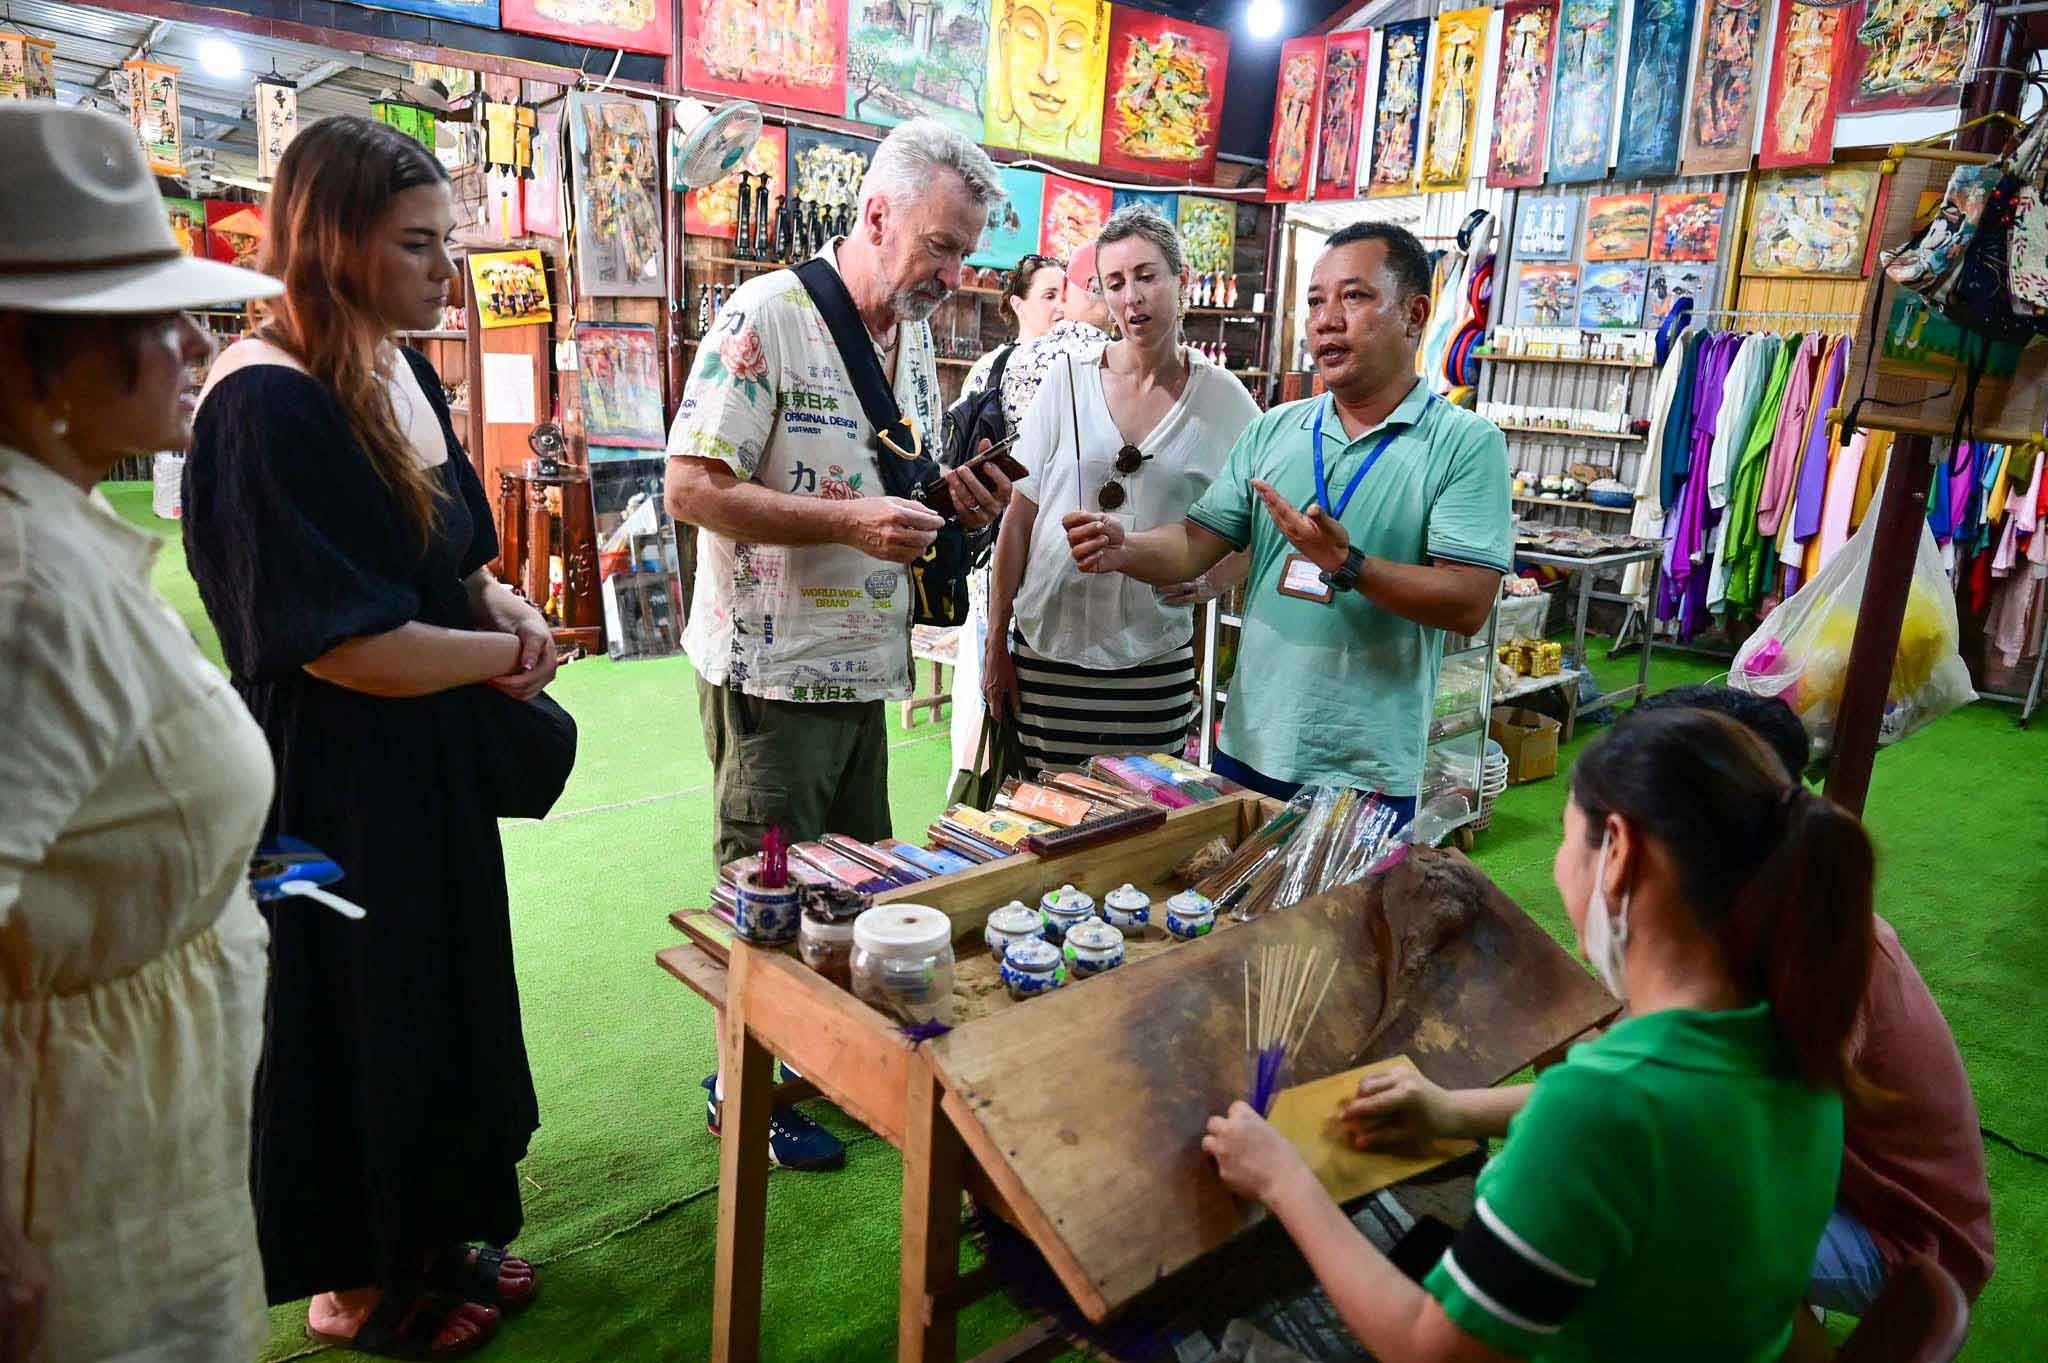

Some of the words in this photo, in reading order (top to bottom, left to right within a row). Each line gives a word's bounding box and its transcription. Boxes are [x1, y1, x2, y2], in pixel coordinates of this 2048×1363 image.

[784, 412, 828, 425] ORIGINAL
[829, 415, 857, 429] DESIGN
[789, 460, 816, 493] 力
[800, 588, 837, 598] WORLD
[839, 589, 863, 599] WIDE
[816, 599, 850, 608] BRAND
[793, 685, 857, 700] 東京日本
